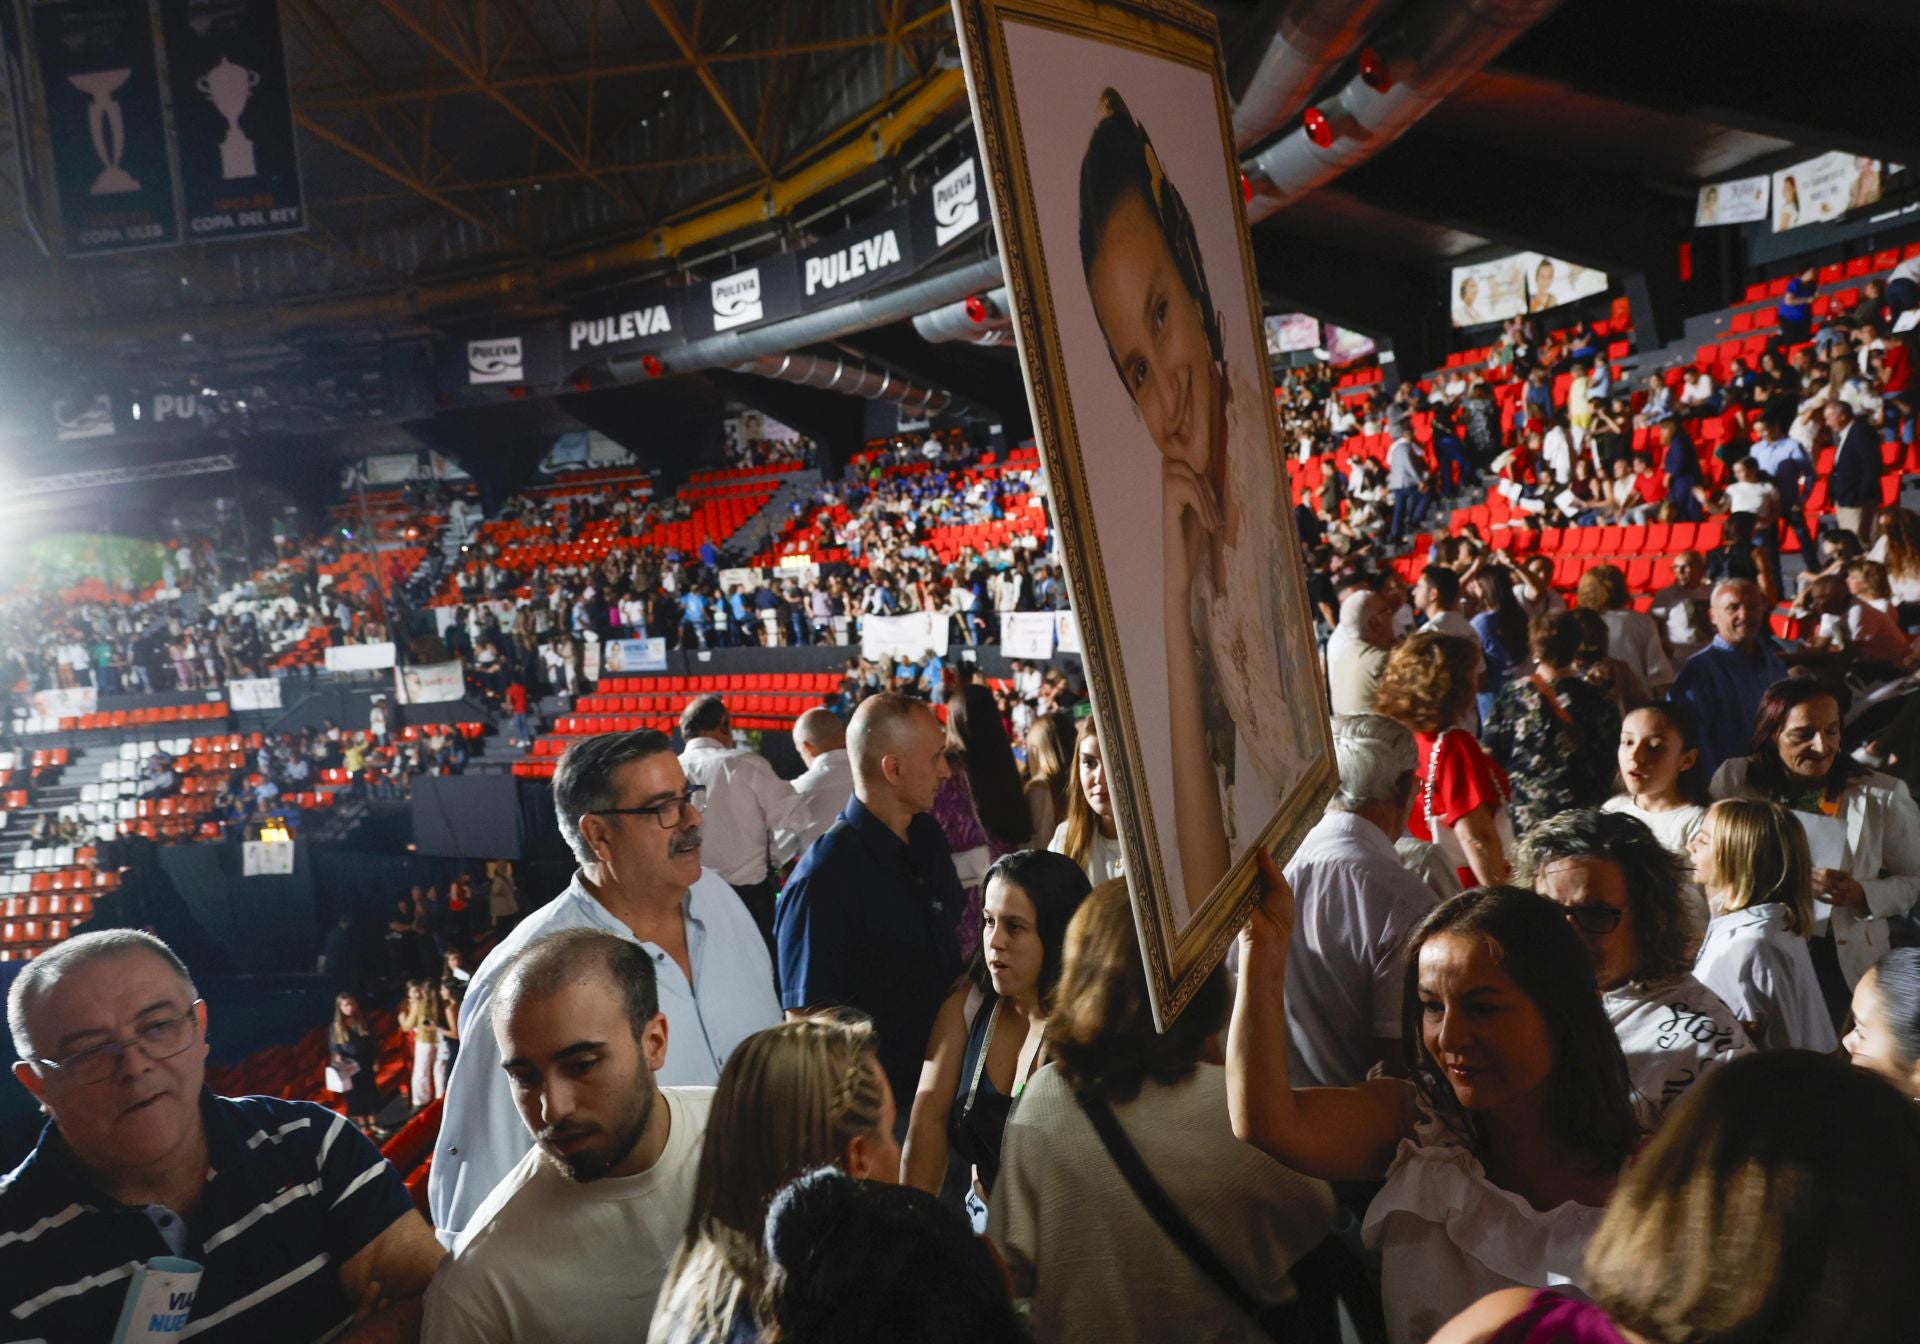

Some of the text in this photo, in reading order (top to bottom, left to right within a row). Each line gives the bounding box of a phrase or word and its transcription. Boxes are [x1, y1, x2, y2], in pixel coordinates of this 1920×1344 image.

[937, 170, 973, 208] PULEVA
[191, 206, 299, 232] COPA DEL REY
[80, 226, 122, 245] COPA
[804, 228, 901, 296] PULEVA
[715, 277, 756, 300] PULEVA
[570, 304, 672, 351] PULEVA
[471, 344, 518, 359] PULEVA
